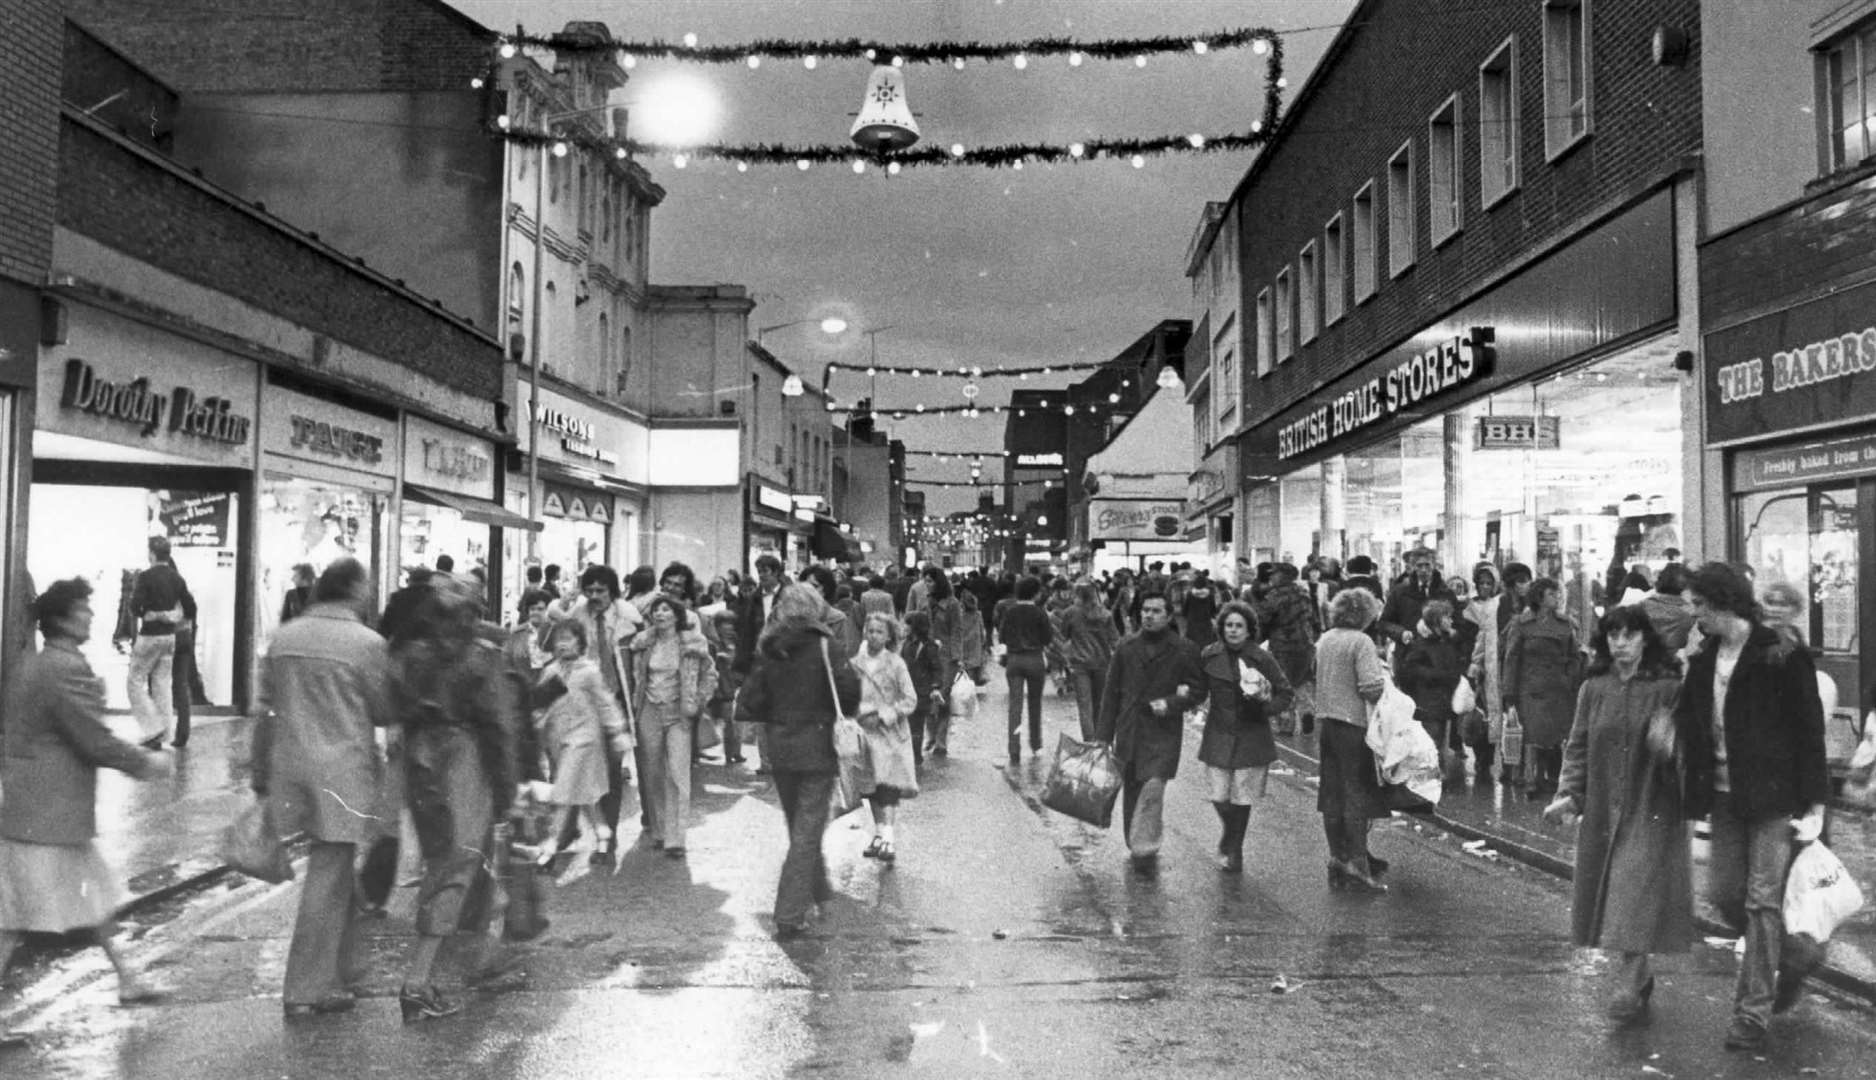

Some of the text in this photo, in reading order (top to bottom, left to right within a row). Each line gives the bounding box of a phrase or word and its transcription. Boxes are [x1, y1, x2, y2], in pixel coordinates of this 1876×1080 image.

[61, 359, 250, 445] Dorothy Perkins
[1278, 324, 1475, 461] BRITISH HOME STORES
[1718, 327, 1876, 404] THE BAKERS
[1763, 458, 1796, 474] Freshly
[1800, 452, 1829, 470] baked
[1834, 449, 1859, 465] from
